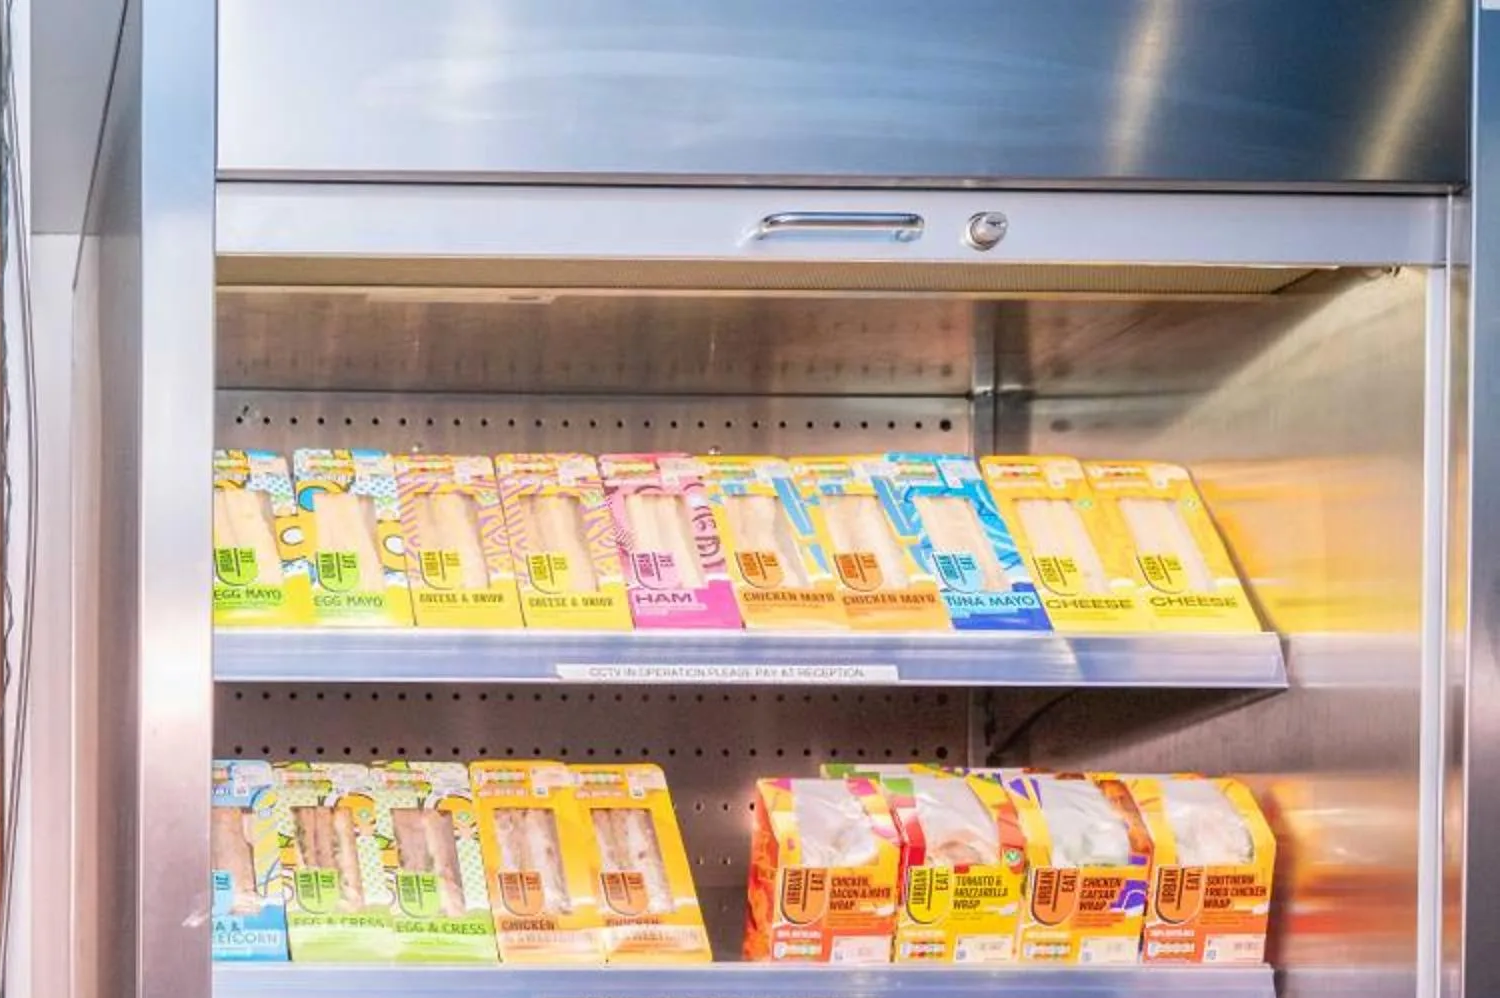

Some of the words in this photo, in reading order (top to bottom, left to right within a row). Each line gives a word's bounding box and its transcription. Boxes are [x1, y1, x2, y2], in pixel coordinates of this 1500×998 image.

[214, 589, 241, 600] EGG
[246, 589, 282, 600] MAYO
[635, 592, 693, 603] HAM
[743, 591, 798, 603] CHICKEN
[800, 591, 835, 602] MAYO
[842, 594, 897, 605] CHICKEN
[347, 596, 383, 608] MAYO
[946, 596, 985, 607] TUNA
[990, 596, 1035, 606] MAYO
[1046, 598, 1133, 610] CHEESE
[1149, 596, 1238, 608] CHEESE
[1082, 877, 1122, 888] CHICKEN
[830, 900, 855, 911] WRAP
[953, 899, 980, 910] WRAP
[1079, 900, 1107, 911] WRAP
[1204, 898, 1231, 909] WRAP
[442, 923, 487, 935] CRESS
[501, 920, 555, 931] CHICKEN
